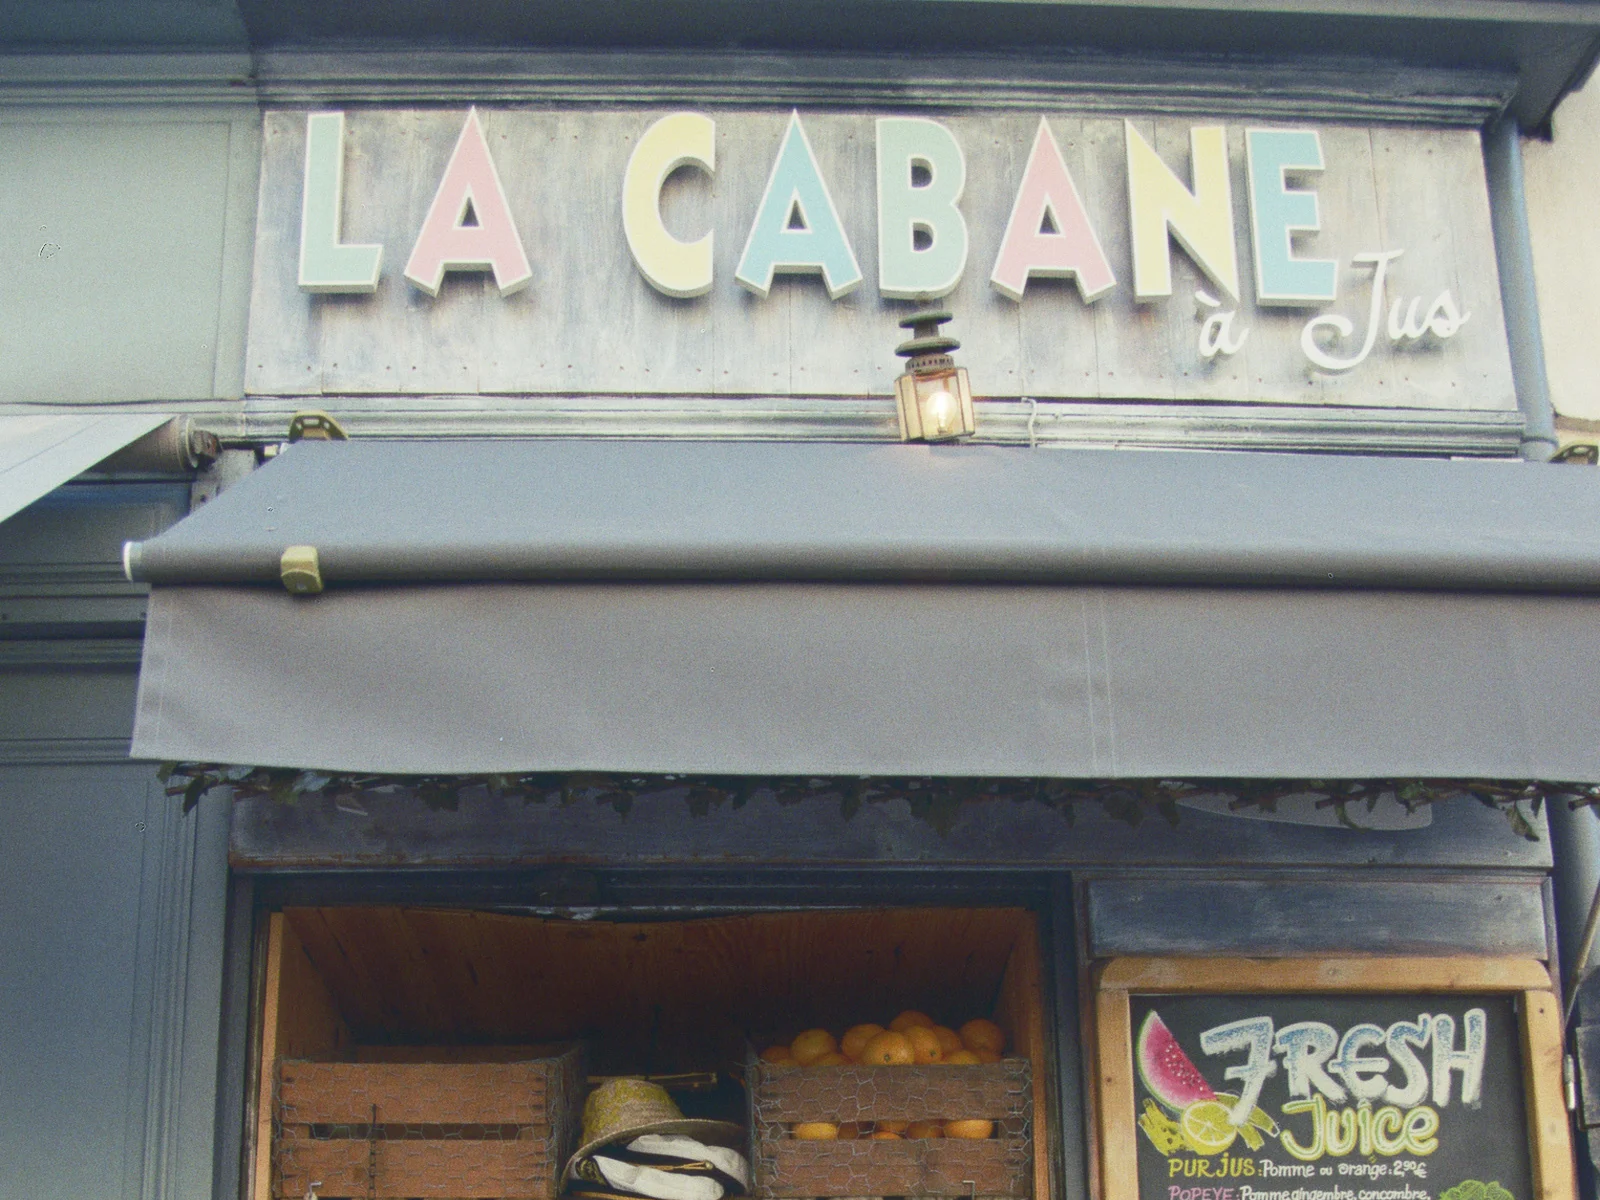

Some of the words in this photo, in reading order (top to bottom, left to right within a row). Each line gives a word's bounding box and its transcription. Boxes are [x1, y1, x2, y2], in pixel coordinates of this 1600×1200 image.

[299, 105, 533, 297] LA
[622, 108, 1339, 306] CABANE
[1195, 289, 1250, 358] à
[1300, 248, 1471, 370] Jus
[1168, 1159, 1214, 1177] PUR
[1260, 1159, 1315, 1178] Pomme
[1320, 1166, 1333, 1176] ou
